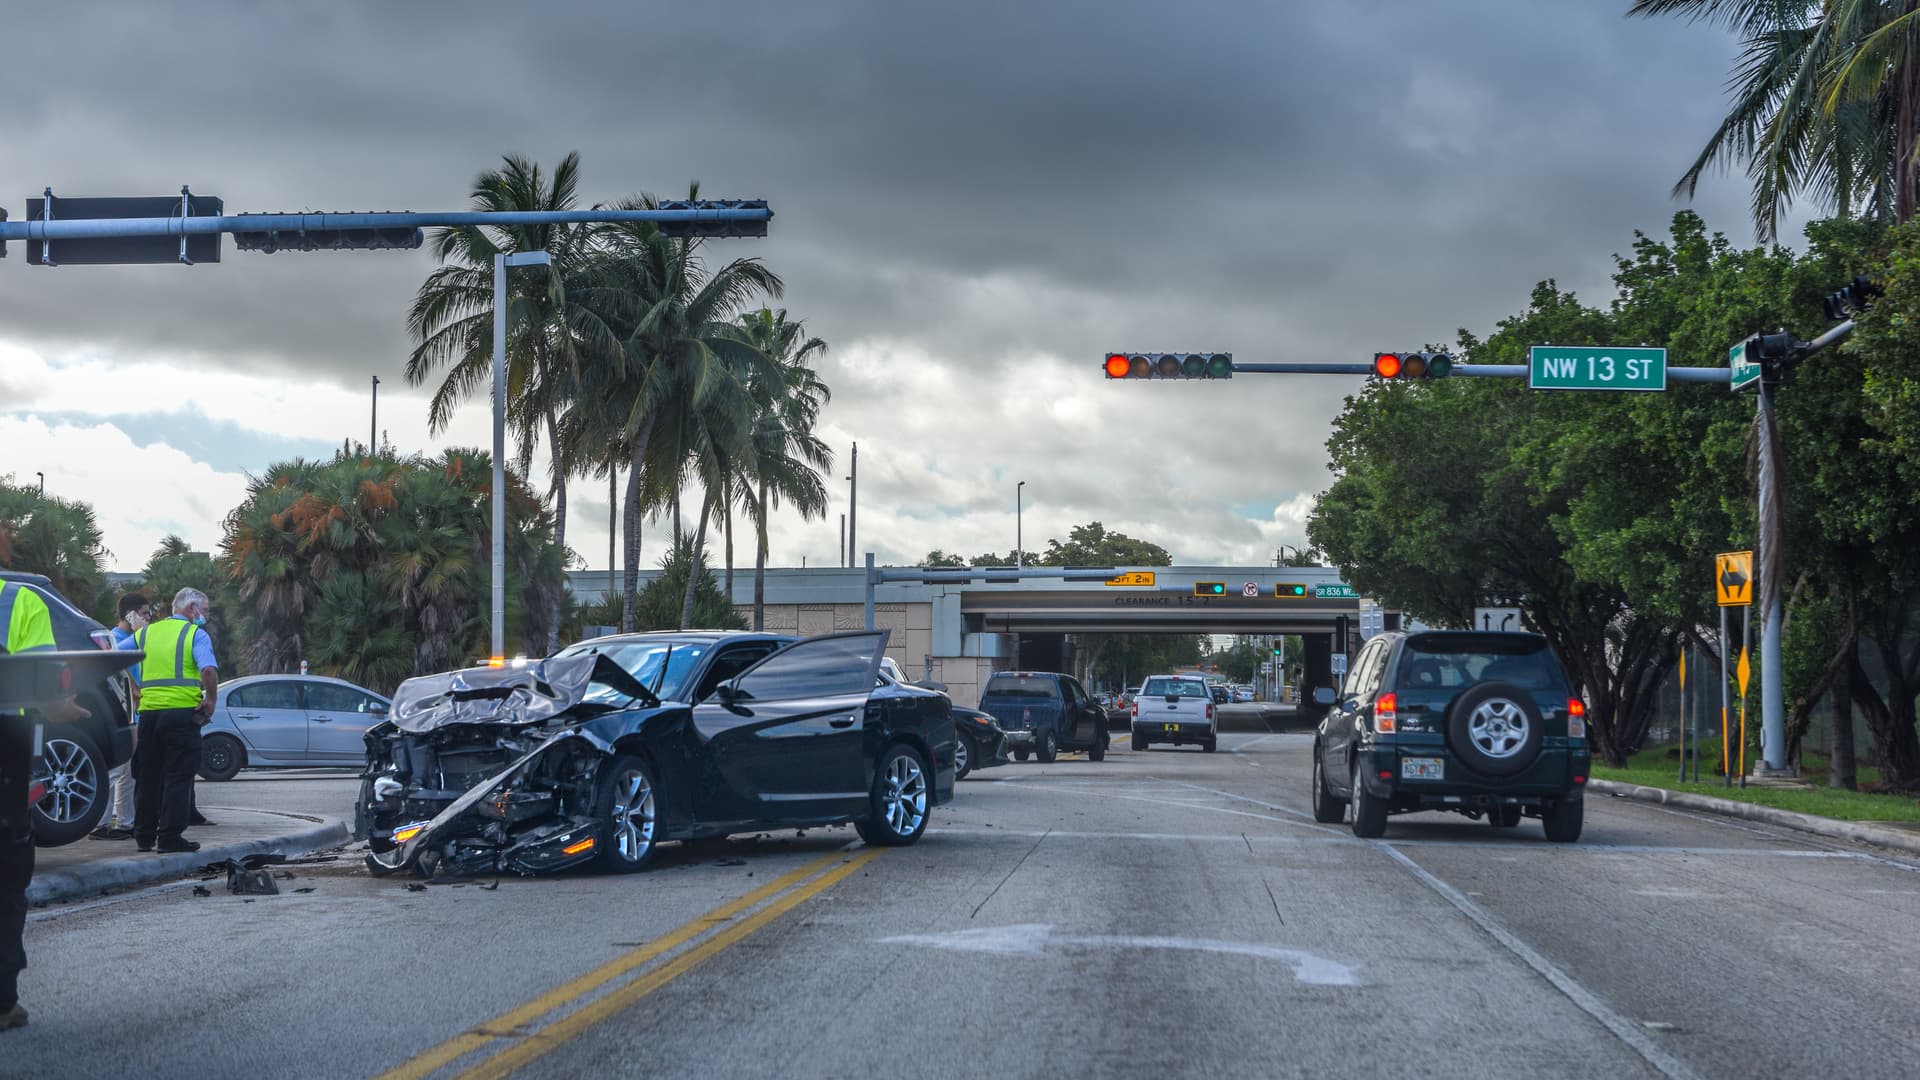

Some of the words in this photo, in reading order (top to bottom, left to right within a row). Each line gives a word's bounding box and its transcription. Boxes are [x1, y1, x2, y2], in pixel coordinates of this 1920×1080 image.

[1543, 358, 1577, 378] NW
[1587, 356, 1615, 381] 13
[1625, 358, 1653, 380] ST
[1317, 588, 1326, 596] SR
[1326, 587, 1341, 596] 836
[1342, 587, 1359, 597] WE
[1114, 597, 1169, 606] CLEARANCE
